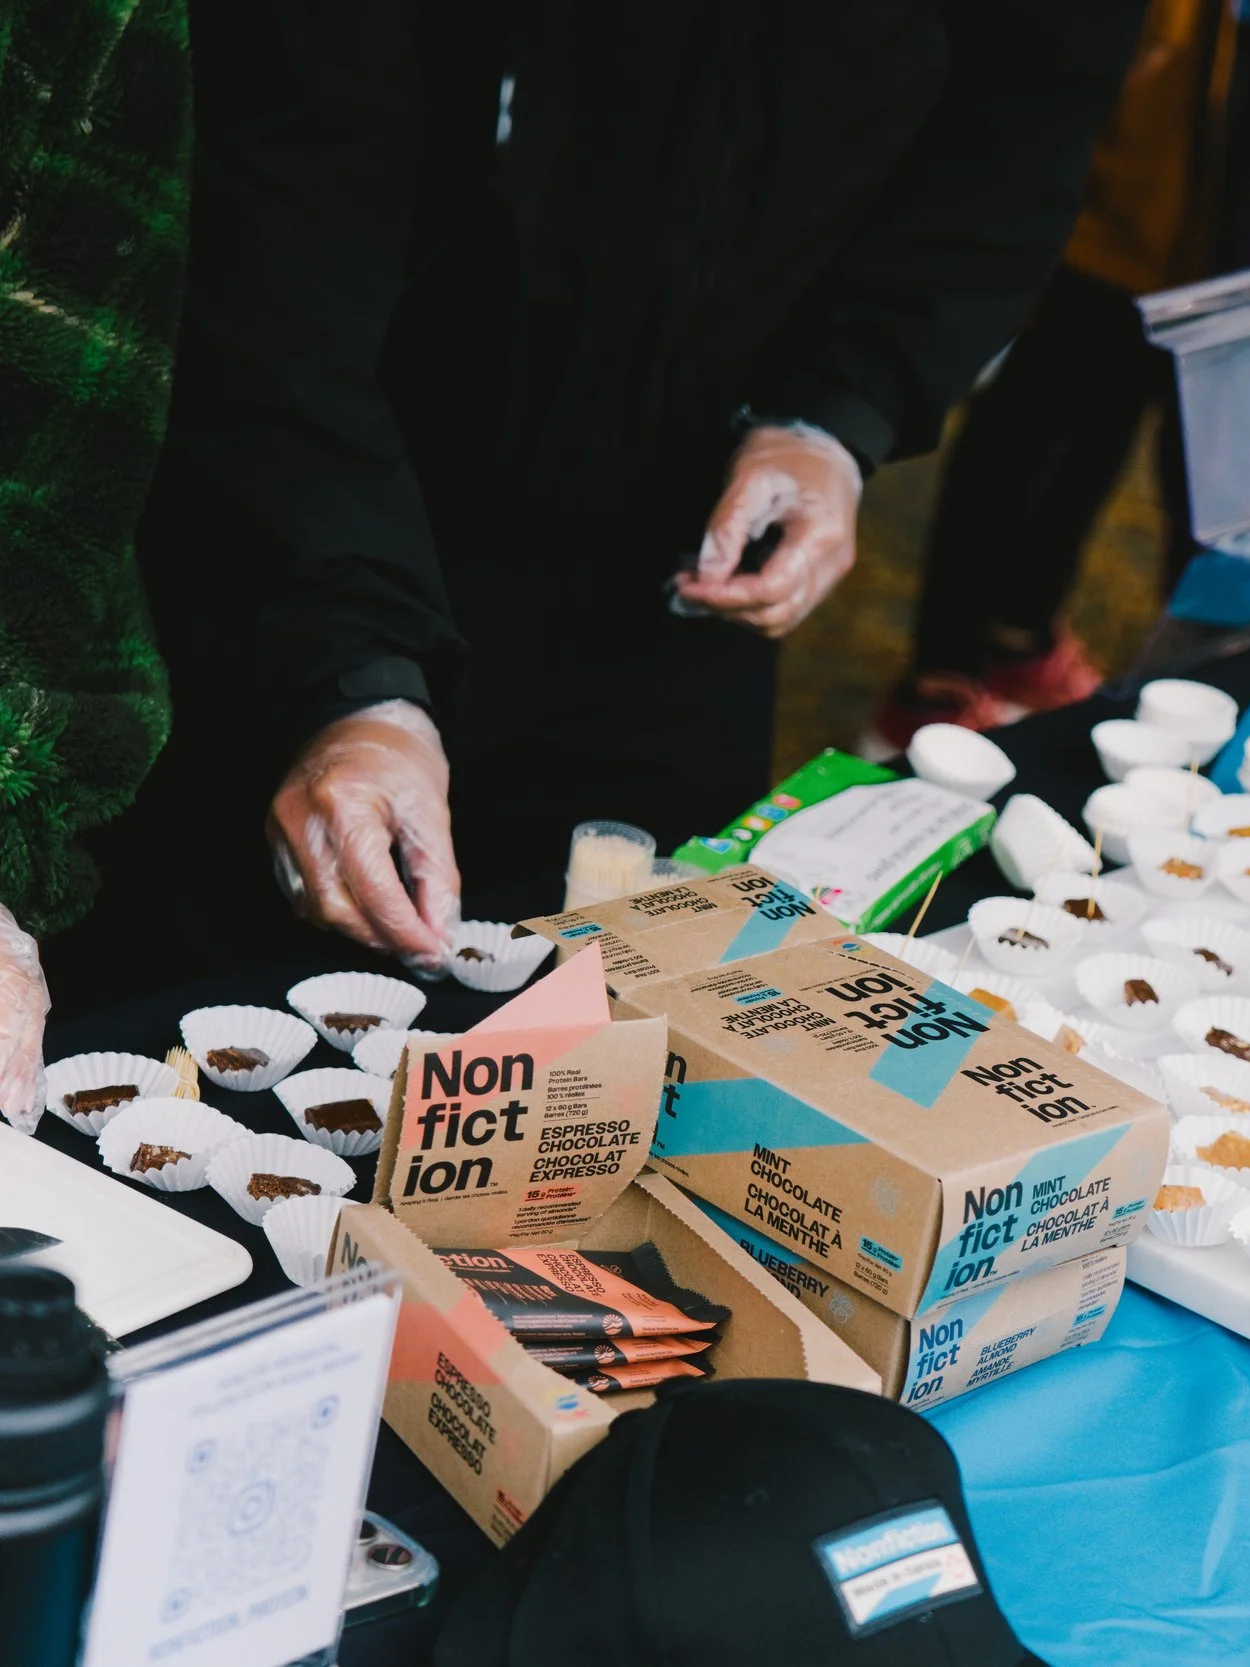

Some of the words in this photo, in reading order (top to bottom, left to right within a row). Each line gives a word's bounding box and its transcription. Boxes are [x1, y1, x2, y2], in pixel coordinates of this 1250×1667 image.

[732, 877, 779, 892] ion
[742, 888, 797, 908] fict
[641, 891, 698, 910] CHOCOLAT
[644, 897, 710, 917] CHOCOLATE
[692, 902, 718, 913] MINT
[760, 901, 817, 920] Non
[824, 973, 916, 1002] ion
[721, 1003, 777, 1023] MENTHE
[740, 1004, 811, 1029] CHOCOLAT
[777, 998, 801, 1008] LA
[843, 992, 947, 1029] fict
[740, 1012, 824, 1039] CHOCOLATE
[801, 1017, 837, 1032] MINT
[880, 1011, 991, 1050] Non
[421, 1050, 534, 1100] Non
[960, 1057, 1045, 1087] Non
[995, 1073, 1074, 1103] fict
[565, 1110, 580, 1118] (720
[1021, 1096, 1091, 1123] ion
[417, 1100, 528, 1150] fict
[540, 1119, 631, 1140] ESPRESSO
[538, 1132, 641, 1153] CHOCOLATE
[529, 1163, 620, 1182] EXPRESSO
[533, 1150, 627, 1170] CHOCOLAT
[753, 1142, 791, 1174] MINT
[403, 1155, 493, 1197] ion
[1032, 1175, 1066, 1199] MINT
[527, 1190, 540, 1198] 15
[537, 1201, 581, 1210] recommended
[751, 1160, 843, 1224] CHOCOLATE
[963, 1180, 1023, 1225] Non
[1030, 1177, 1111, 1215] CHOCOLATE
[517, 1217, 540, 1225] portion
[541, 1214, 576, 1222] quotidienne
[744, 1198, 764, 1221] LA
[767, 1214, 830, 1258] MENTHE
[747, 1183, 830, 1239] CHOCOLAT
[831, 1229, 843, 1250] À
[1026, 1201, 1100, 1237] CHOCOLAT
[1099, 1196, 1109, 1213] À
[861, 1238, 873, 1250] 15
[958, 1214, 1018, 1259] fict
[1020, 1237, 1039, 1252] LA
[1041, 1216, 1097, 1246] MENTHE
[536, 1253, 575, 1293] EXPRESSO
[547, 1254, 585, 1294] CHOCOLAT
[559, 1254, 601, 1297] CHOCOLATE
[568, 1254, 606, 1294] ESPRESSO
[740, 1239, 830, 1298] BLUEBERRY
[853, 1270, 870, 1283] Barres
[876, 1273, 888, 1284] Bars
[944, 1255, 995, 1292] ion
[918, 1317, 963, 1354] Non
[980, 1326, 1037, 1356] BLUEBERRY
[916, 1343, 960, 1379] fict
[970, 1355, 1012, 1378] AMANDE
[976, 1343, 1018, 1366] ALMOND
[437, 1351, 491, 1418] ESPRESSO
[907, 1376, 943, 1403] ion
[966, 1362, 1014, 1388] MYRTILLE
[435, 1369, 497, 1445] CHOCOLATE
[431, 1392, 486, 1459] CHOCOLAT
[428, 1407, 482, 1475] EXPRESSO
